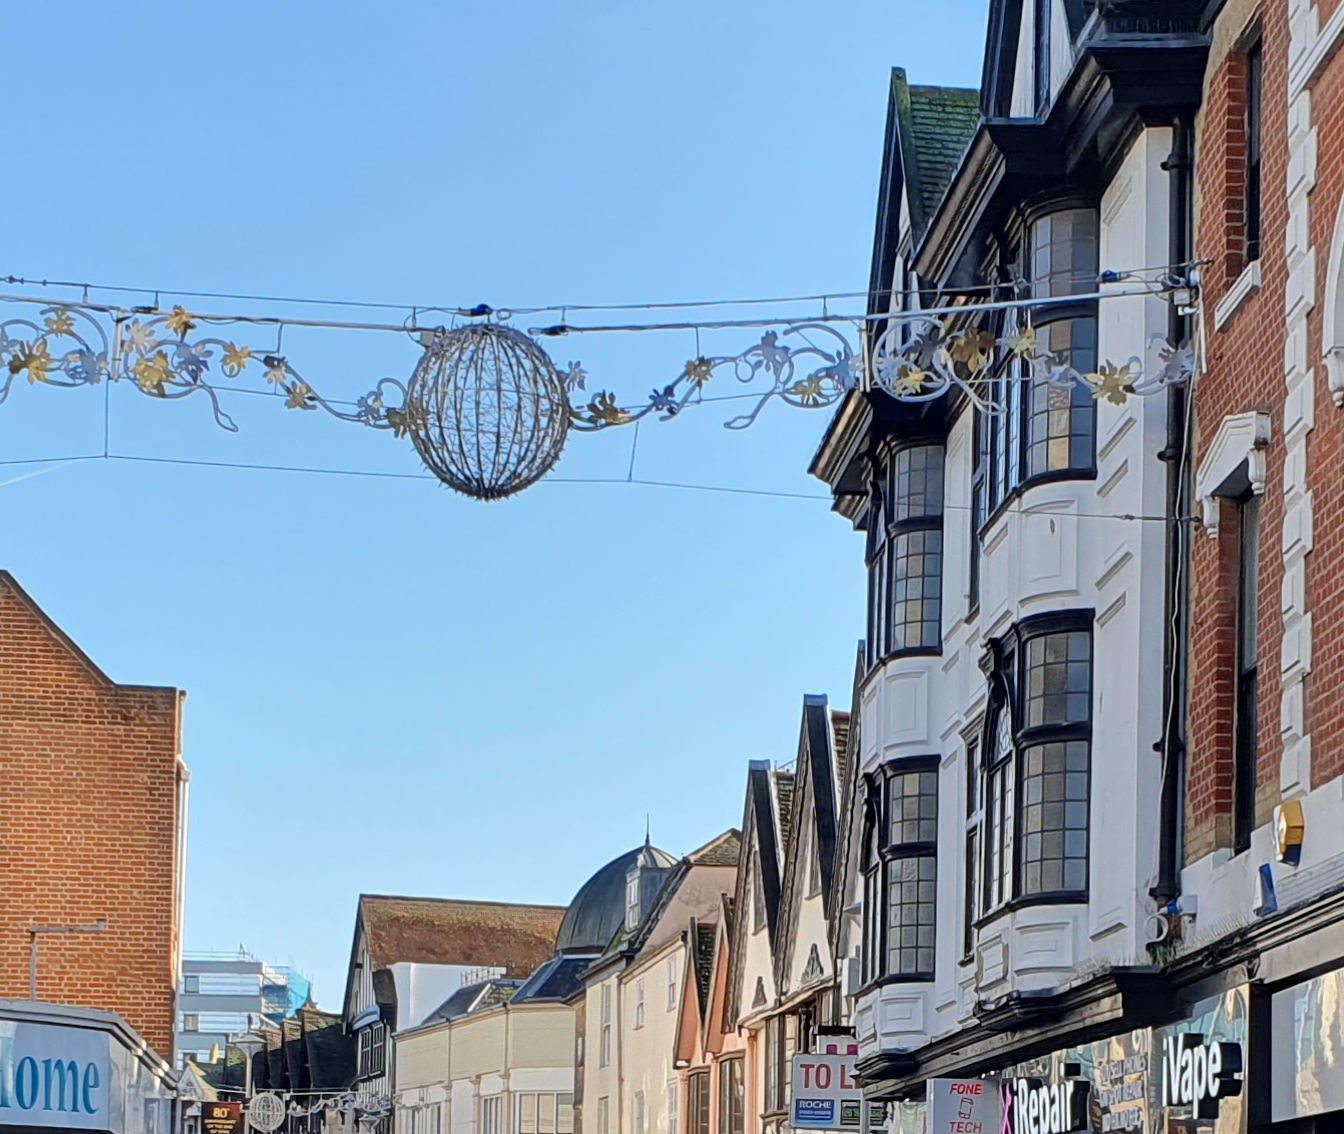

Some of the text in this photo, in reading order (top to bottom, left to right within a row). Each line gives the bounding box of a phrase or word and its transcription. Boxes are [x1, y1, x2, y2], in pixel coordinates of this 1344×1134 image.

[799, 1063, 832, 1089] TO
[1161, 1032, 1222, 1120] iVape
[949, 1083, 983, 1095] FONE
[949, 1121, 983, 1134] TECH
